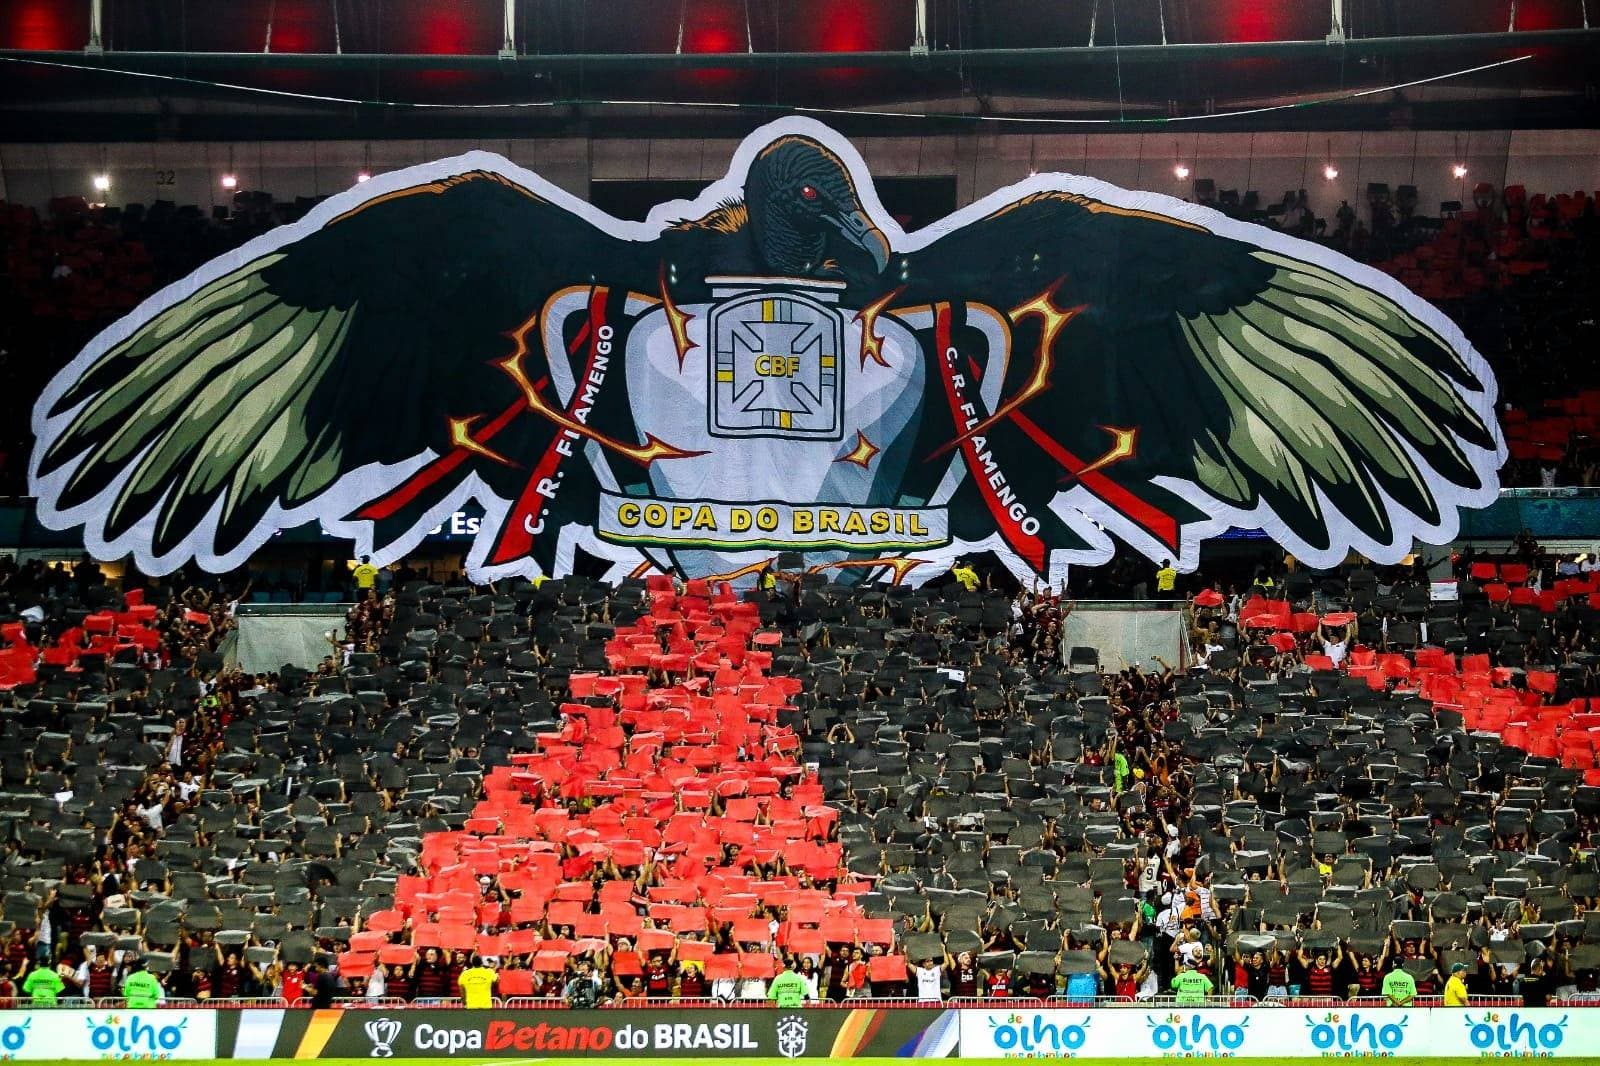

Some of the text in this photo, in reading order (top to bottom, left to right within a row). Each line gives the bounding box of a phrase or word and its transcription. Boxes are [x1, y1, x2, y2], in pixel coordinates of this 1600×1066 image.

[156, 170, 176, 185] 32
[755, 354, 800, 378] CBF
[960, 402, 1041, 536] FLAMENGO
[451, 511, 484, 535] Es
[617, 502, 929, 536] COPA DO BRASIL
[1146, 867, 1154, 881] 9
[106, 1015, 121, 1025] de
[1007, 1013, 1023, 1024] de
[1166, 1012, 1181, 1023] de
[1324, 1012, 1340, 1023] de
[1483, 1011, 1499, 1023] de
[91, 1015, 182, 1051] olho
[414, 1020, 759, 1055] Copa Betano do BRASIL
[994, 1014, 1086, 1051] olho
[1152, 1014, 1244, 1051] olho
[1311, 1013, 1403, 1050] olho
[1470, 1013, 1563, 1050] olho
